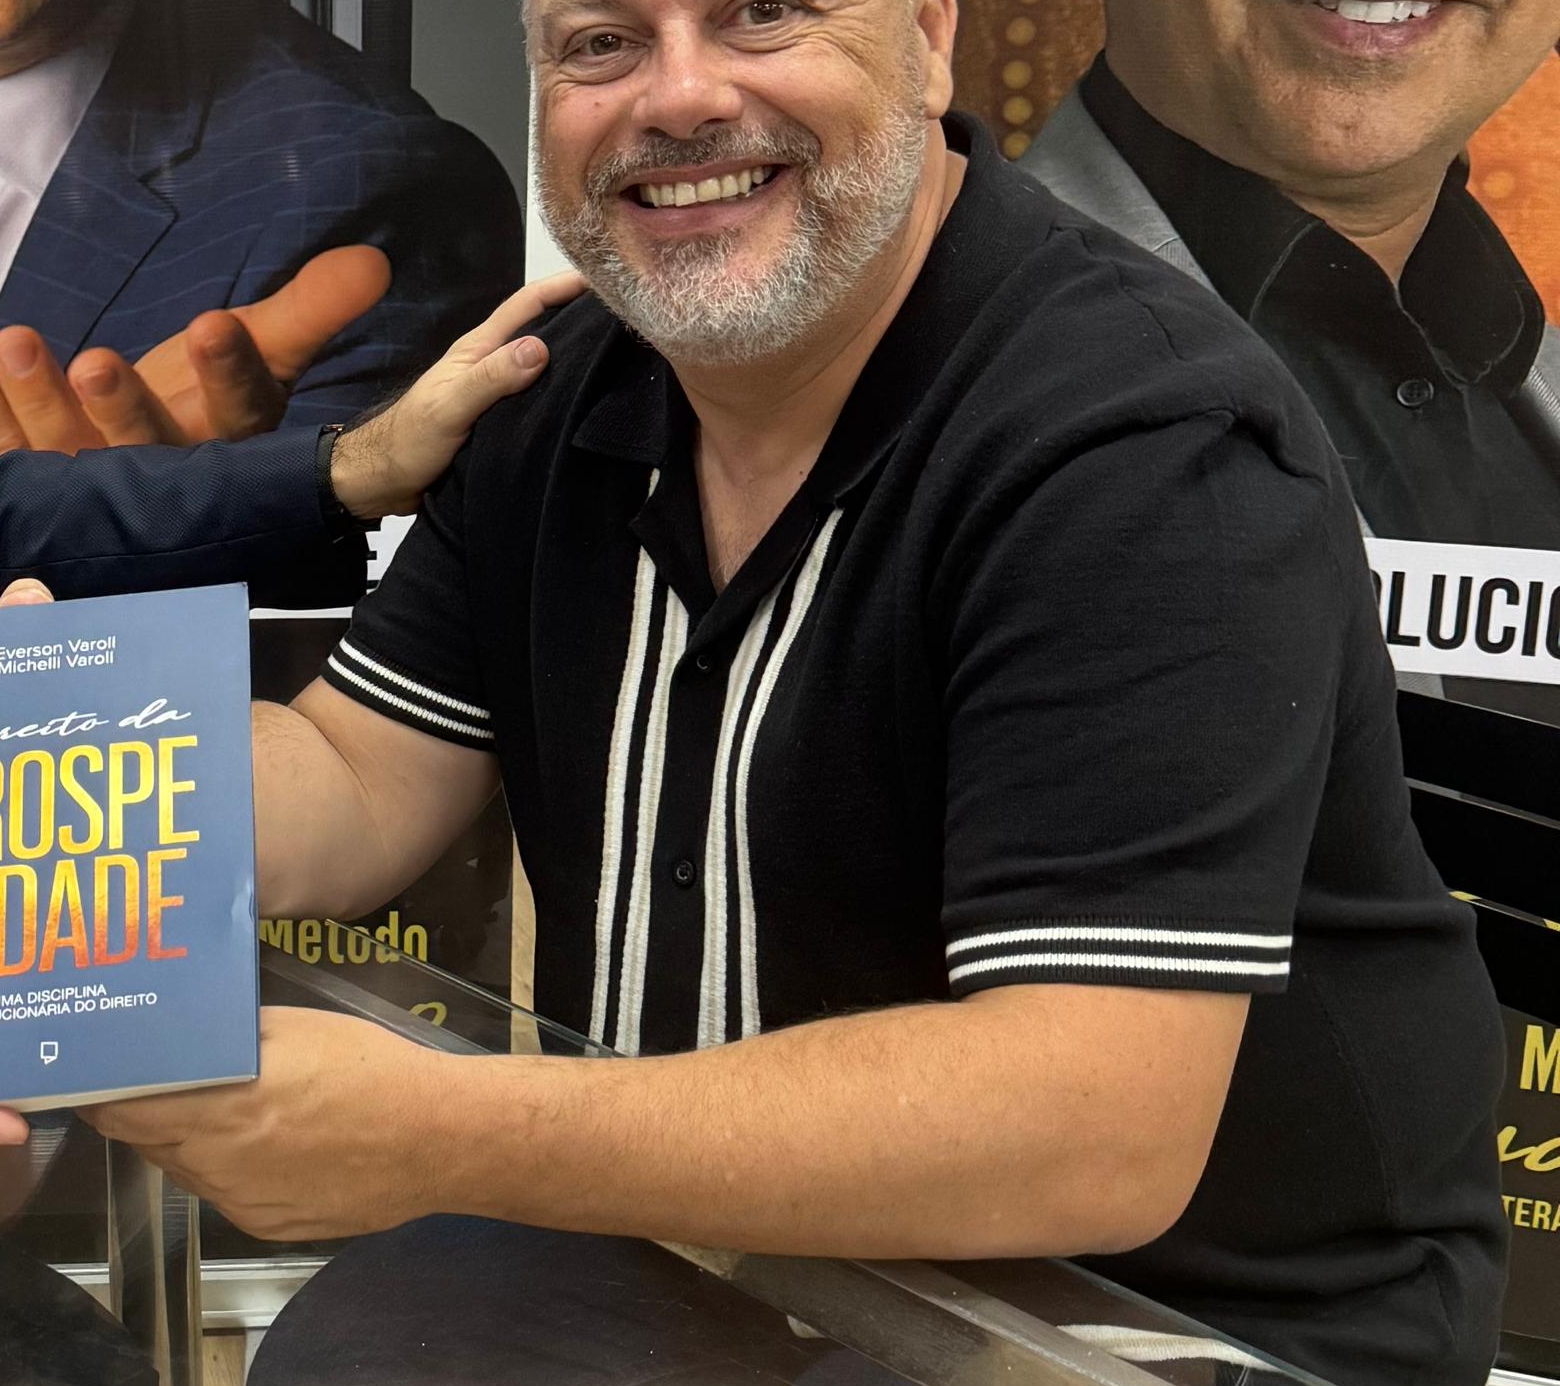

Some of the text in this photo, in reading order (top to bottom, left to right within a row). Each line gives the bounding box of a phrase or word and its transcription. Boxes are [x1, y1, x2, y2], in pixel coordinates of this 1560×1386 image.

[67, 635, 117, 653] Varoll
[65, 650, 114, 668] Varoll
[119, 698, 192, 729] da
[27, 983, 107, 1004] DISCIPLINA
[74, 999, 96, 1014] DO
[100, 992, 158, 1010] DIREITO
